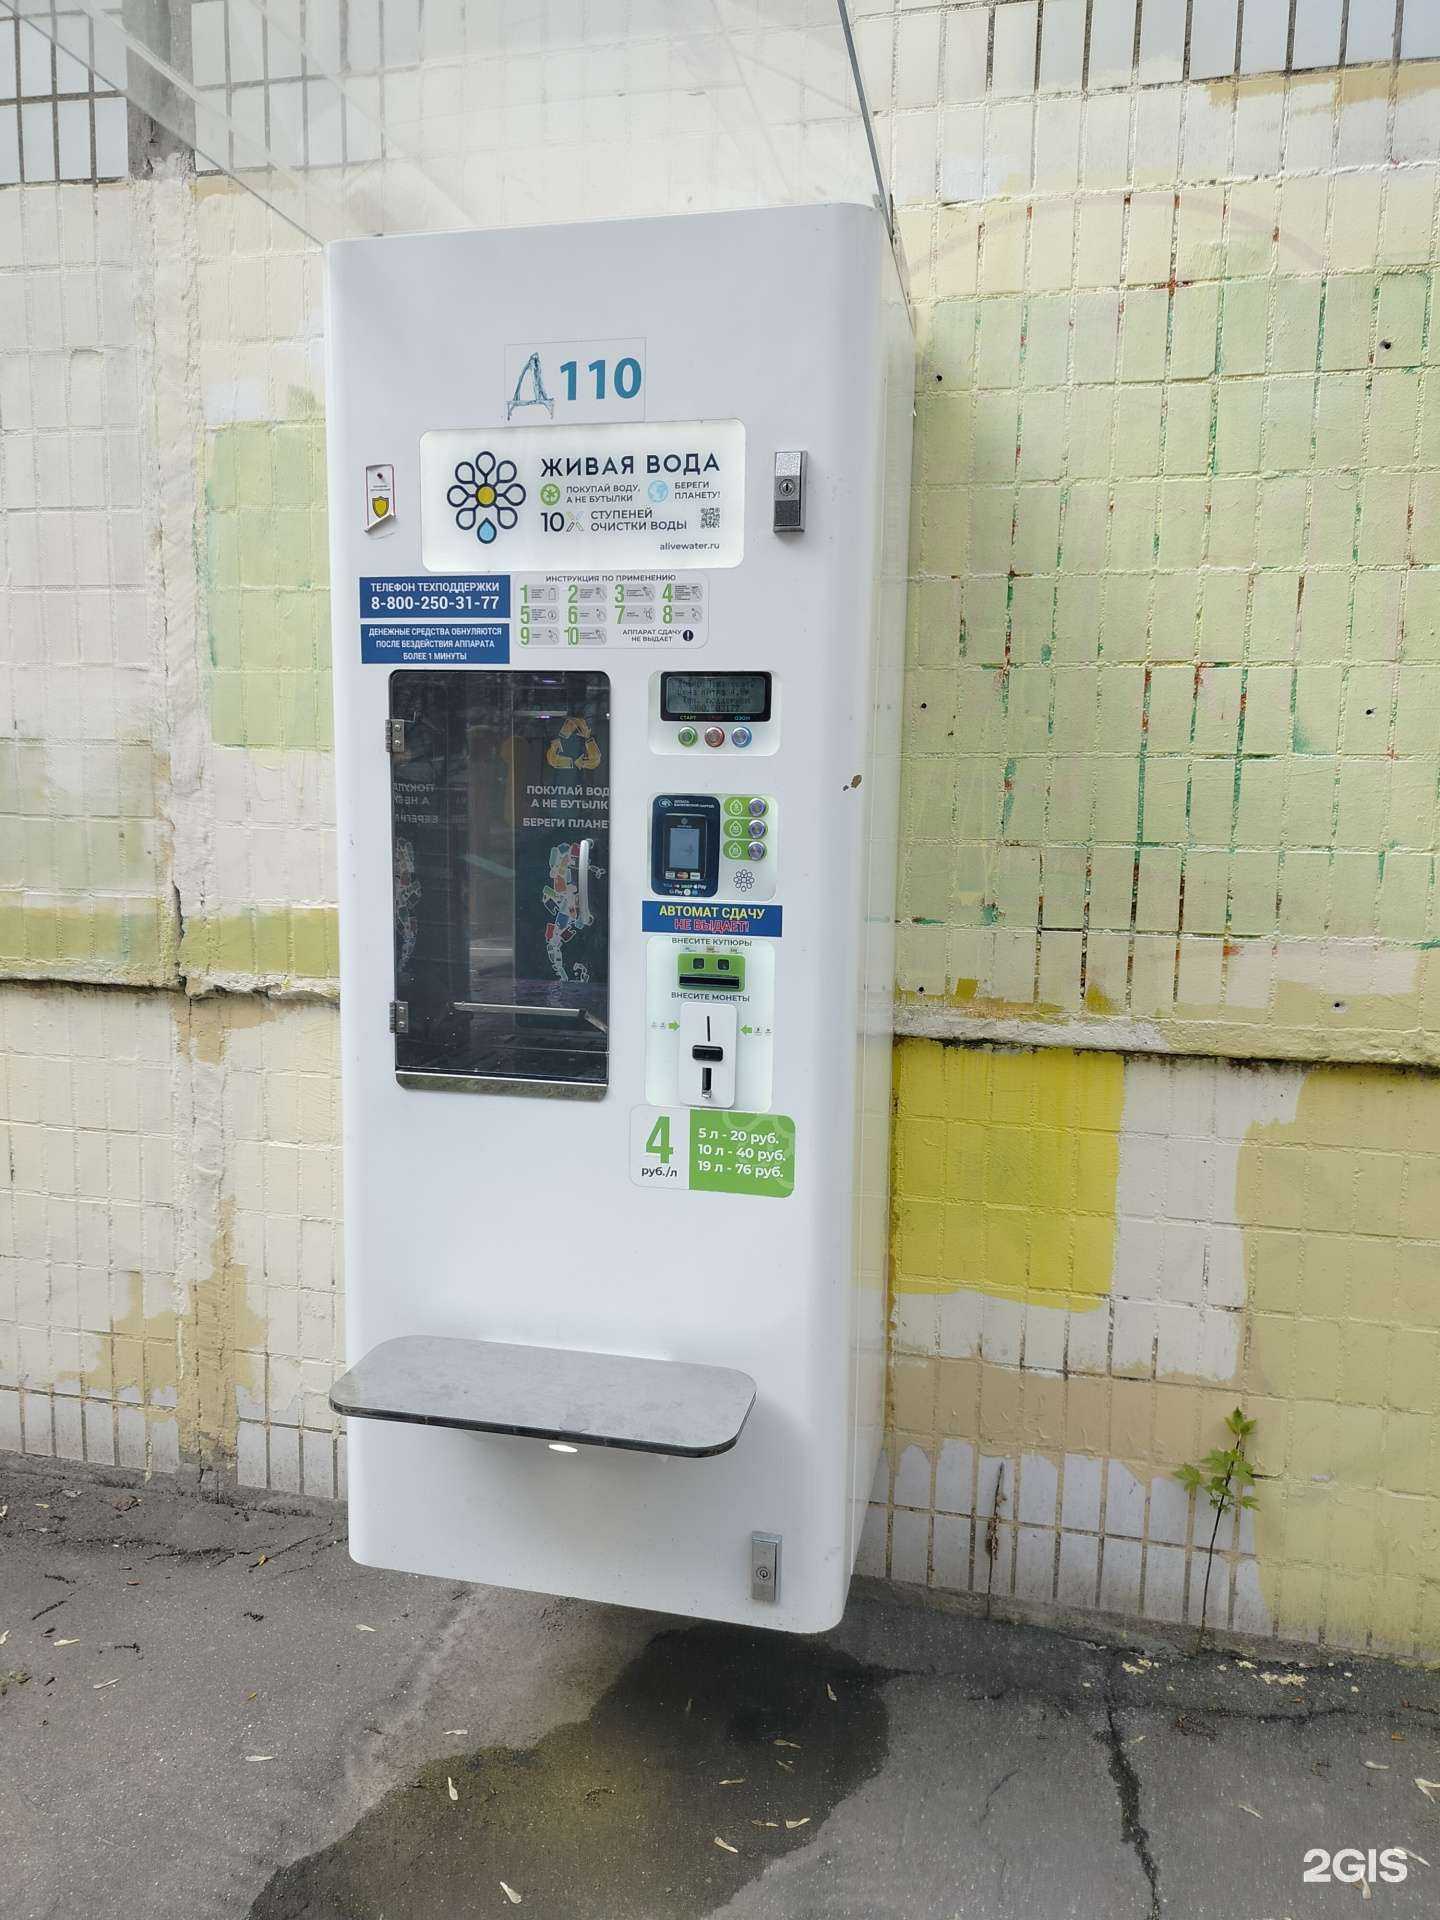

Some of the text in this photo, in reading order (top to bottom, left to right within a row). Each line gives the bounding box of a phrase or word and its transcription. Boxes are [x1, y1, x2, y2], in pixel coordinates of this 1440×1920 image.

[540, 453, 720, 477] ЖИВАЯ ВОДА
[566, 484, 612, 494] ПОКУПАЙ
[674, 481, 710, 489] БЕРЕГИ
[575, 496, 587, 504] НЕ
[590, 495, 633, 503] БУТЫЛКИ
[674, 491, 720, 500] ПЛАНЕТУ!
[591, 507, 653, 519] СТУПЕНЕЙ
[591, 520, 687, 532] ОЧИСТКИ ВОДЫ
[660, 542, 720, 551] alivewater.ru
[371, 582, 500, 593] ТЕЛЕФОН ТЕХПОДДЕРЖКИ
[520, 585, 528, 603] 1
[568, 584, 578, 603] 2
[614, 584, 625, 603] 3
[662, 583, 673, 602] 4
[371, 596, 499, 610] 8-800-250-31-77
[520, 605, 530, 625] 5
[568, 605, 578, 625] 6
[614, 605, 626, 624] 7
[662, 605, 673, 624] 8
[369, 627, 502, 637] ДЕНЕЖНЫЕ СРЕДСТВА ОБНУЛЯЮТСЯ
[520, 627, 530, 646] 9
[564, 627, 579, 645] 10
[376, 639, 495, 649] ПОСЛЕ БЕЗДЕЙСТВИЯ АППАРАТА
[403, 652, 427, 660] БОЛЕЕ
[434, 652, 467, 660] МИНУТЫ
[526, 785, 583, 796] ПОКУПАЙ
[530, 799, 608, 809] А НЕ БУТЫЛК
[523, 818, 609, 829] БЕРЕГИ ПЛАНЕ
[659, 905, 766, 920] АВТОМАТ СДАЧУ
[674, 919, 750, 933] НЕ ВЫДАЕТ!
[671, 937, 752, 946] ВНЕСИТЕ КУПЮРЫ
[671, 991, 750, 1002] ВНЕСИТЕ МОНЕТЫ
[645, 1115, 674, 1164] 4
[699, 1127, 707, 1138] 5
[709, 1131, 718, 1139] л
[730, 1130, 746, 1141] 20
[751, 1132, 779, 1144] руб.
[698, 1144, 712, 1155] 10
[715, 1147, 724, 1155] л
[736, 1147, 754, 1158] 40
[758, 1149, 786, 1162] руб.
[641, 1166, 678, 1178] руб./л
[698, 1160, 711, 1171] 19
[714, 1164, 724, 1172] л
[735, 1163, 752, 1174] 76
[755, 1165, 784, 1178] руб.
